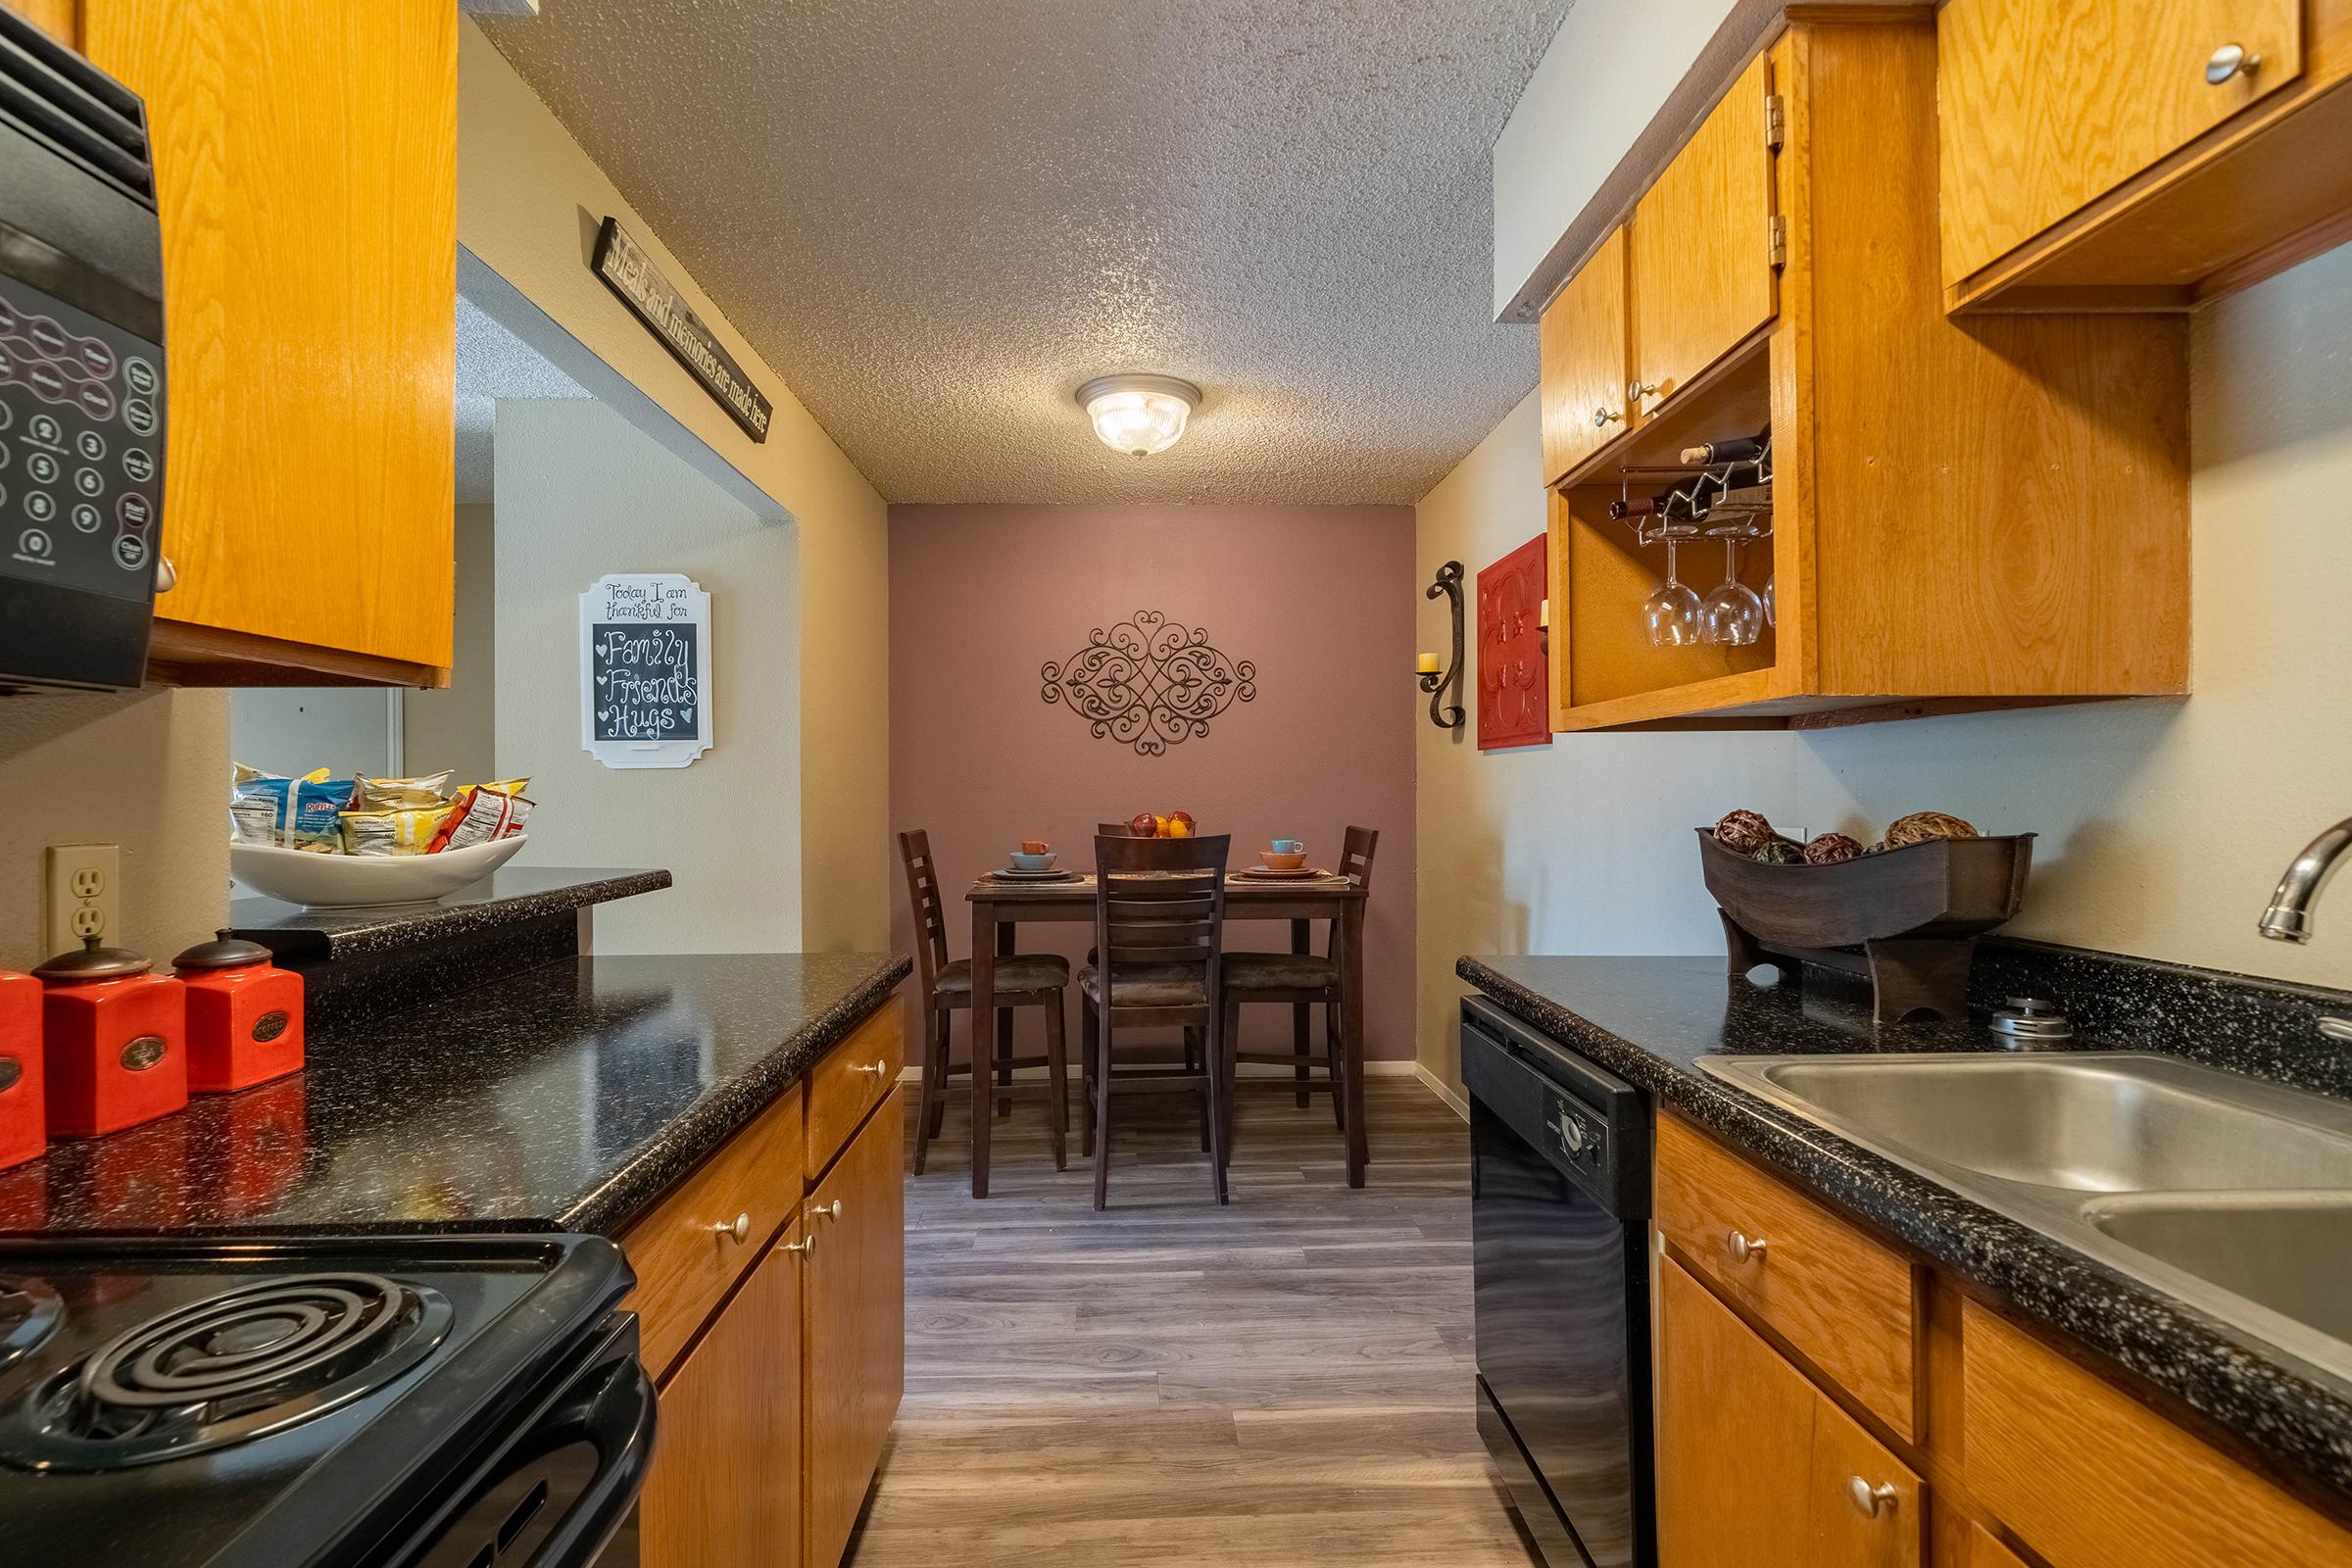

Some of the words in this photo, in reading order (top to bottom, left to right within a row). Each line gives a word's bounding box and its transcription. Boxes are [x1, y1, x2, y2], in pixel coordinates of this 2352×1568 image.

[609, 235, 649, 303] Meals
[645, 293, 673, 328] and
[668, 316, 716, 378] memories
[715, 364, 731, 394] are
[728, 380, 753, 418] made
[749, 392, 767, 433] here
[83, 347, 110, 365] Timer
[82, 391, 109, 408] Clock
[39, 421, 53, 438] 2
[85, 437, 98, 454] 3
[36, 460, 49, 475] 5
[83, 474, 95, 489] 6
[32, 498, 47, 514] 8
[80, 511, 93, 525] 9
[28, 535, 43, 551] 0
[121, 541, 142, 553] Clear
[606, 583, 647, 605] Today
[650, 582, 664, 604] I
[666, 588, 688, 600] am
[605, 601, 662, 620] thankful
[666, 603, 688, 620] for
[604, 629, 689, 688] Family
[605, 668, 698, 706] Friends
[609, 704, 676, 741] Hugs
[258, 1020, 284, 1035] COFFEE
